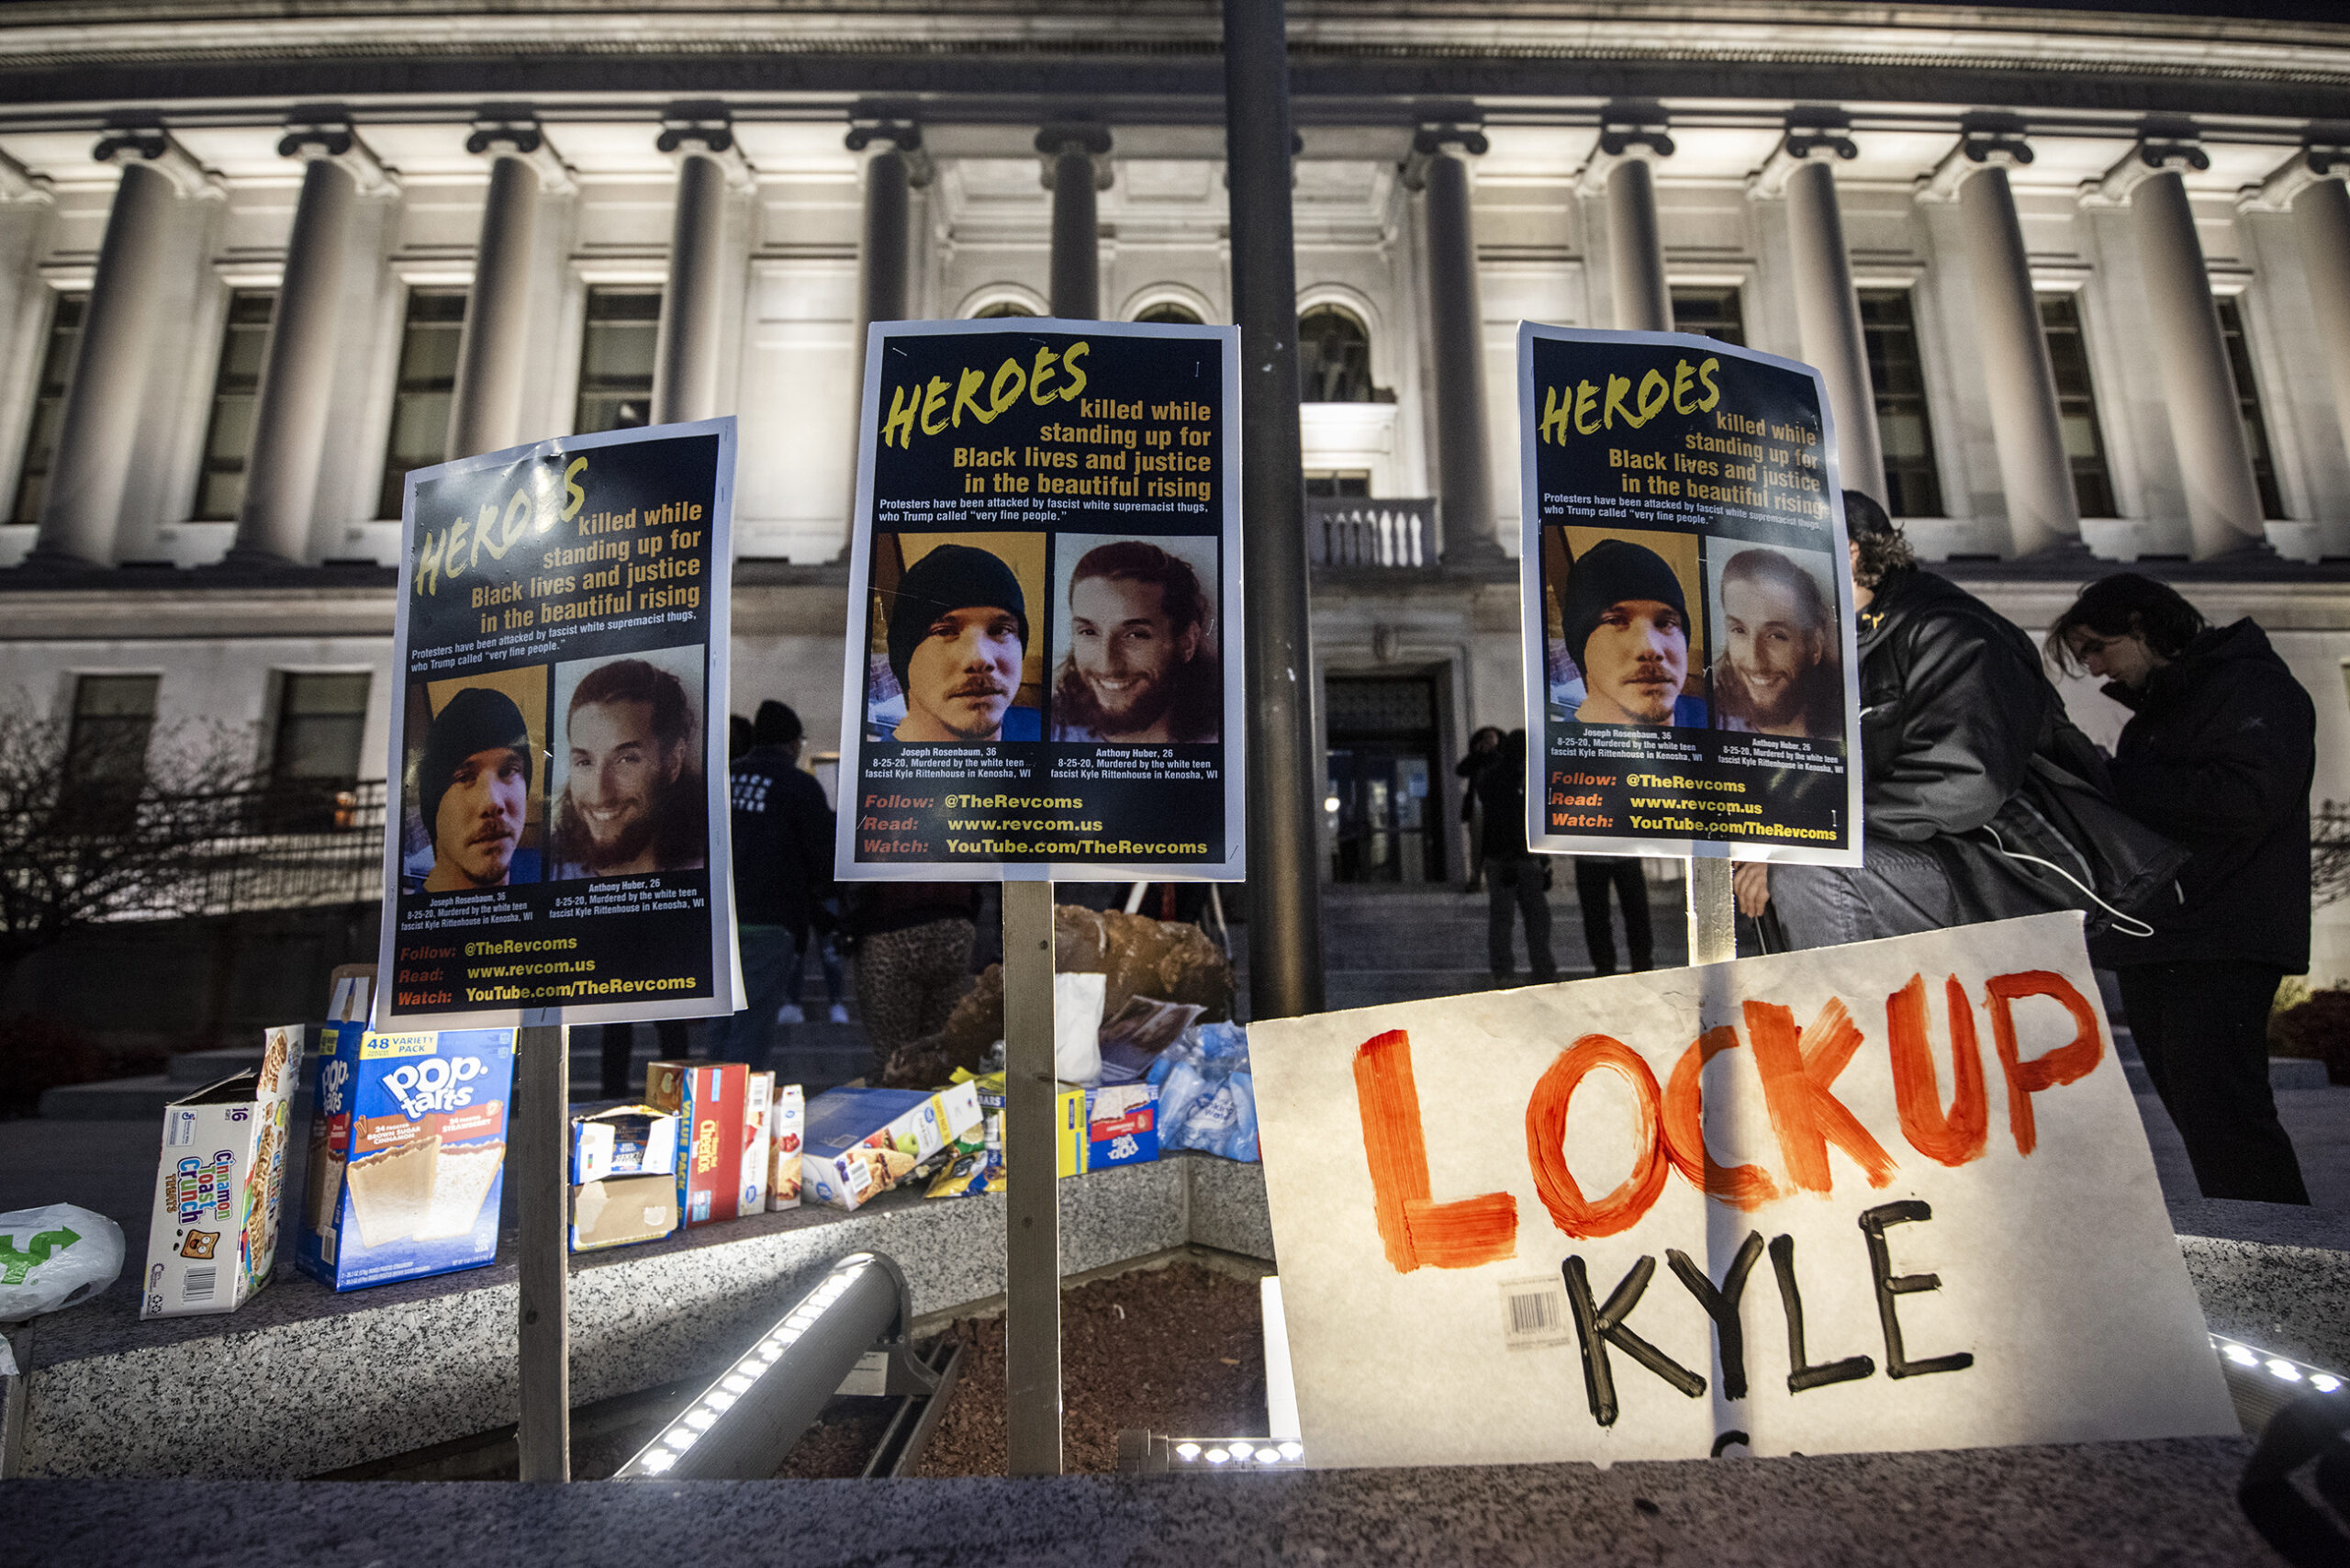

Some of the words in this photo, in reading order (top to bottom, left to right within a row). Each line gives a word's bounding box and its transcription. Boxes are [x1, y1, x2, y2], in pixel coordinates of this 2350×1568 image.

[880, 342, 1089, 449] HEROES
[1080, 398, 1143, 420] killed
[1151, 401, 1211, 420] while
[1538, 358, 1719, 446] HEROES
[1040, 422, 1136, 449] standing
[1145, 430, 1171, 450] up
[1180, 426, 1211, 446] for
[1716, 410, 1765, 436] killed
[1771, 423, 1819, 450] while
[953, 446, 1016, 467] Black
[1024, 446, 1078, 468] lives
[1085, 450, 1125, 470] and
[1134, 451, 1211, 475] justice
[1685, 431, 1763, 463] standing
[1769, 447, 1789, 467] up
[1795, 449, 1818, 467] for
[965, 473, 984, 493] in
[992, 472, 1029, 493] the
[1037, 473, 1138, 497] beautiful
[1147, 476, 1211, 501] rising
[1609, 448, 1667, 470] Black
[1673, 454, 1718, 476] lives
[1724, 464, 1756, 482] and
[1762, 465, 1820, 497] justice
[879, 498, 930, 509] Protesters
[933, 498, 957, 509] have
[959, 498, 984, 508] been
[987, 498, 1029, 508] attacked
[1032, 499, 1045, 510] by
[1047, 499, 1080, 509] fascist
[1082, 500, 1110, 510] white
[1113, 501, 1174, 512] supremacist
[1621, 473, 1640, 493] in
[1647, 476, 1680, 496] the
[1686, 479, 1769, 510] beautiful
[1774, 493, 1830, 520] rising
[578, 508, 636, 536] killed
[643, 501, 702, 526] while
[878, 511, 900, 521] who
[902, 510, 933, 522] Trump
[936, 510, 967, 521] called
[1000, 510, 1019, 520] fine
[543, 539, 630, 568] standing
[637, 535, 663, 557] up
[670, 529, 701, 550] for
[472, 580, 523, 609] Black
[530, 575, 576, 598] lives
[582, 566, 620, 589] and
[626, 558, 699, 588] justice
[481, 612, 497, 633] in
[503, 608, 533, 629] the
[541, 590, 632, 623] beautiful
[640, 586, 699, 610] rising
[411, 645, 453, 659] Protesters
[454, 642, 475, 653] have
[476, 638, 497, 649] been
[498, 631, 533, 645] attacked
[536, 630, 546, 641] by
[548, 625, 577, 637] fascist
[579, 622, 605, 633] white
[607, 614, 665, 630] supremacist
[410, 661, 428, 672] who
[430, 658, 455, 669] Trump
[457, 652, 483, 666] called
[509, 646, 525, 656] fine
[901, 747, 930, 757] Joseph
[985, 747, 996, 756] 36
[911, 758, 951, 767] Murdered
[953, 758, 963, 768] by
[965, 758, 979, 767] the
[980, 758, 1003, 767] white
[1005, 758, 1024, 767] teen
[1095, 748, 1130, 759] Anthony
[1162, 748, 1173, 757] 26
[1096, 758, 1136, 768] Murdered
[1139, 759, 1149, 769] by
[1151, 759, 1165, 768] the
[1167, 759, 1190, 768] white
[1192, 760, 1211, 768] teen
[865, 768, 892, 778] fascist
[895, 769, 913, 779] Kyle
[915, 768, 965, 778] Rittenhouse
[968, 768, 976, 778] in
[1019, 768, 1031, 778] WI
[1050, 769, 1078, 778] fascist
[1080, 769, 1099, 779] Kyle
[1102, 769, 1151, 778] Rittenhouse
[1154, 770, 1162, 778] in
[1206, 770, 1217, 778] WI
[1551, 771, 1617, 786] Follow:
[1626, 773, 1746, 792] @TheRevcoms
[865, 794, 934, 808] Follow:
[945, 794, 1083, 808] @TheRevcoms
[1552, 793, 1603, 808] Read:
[1629, 797, 1762, 814] www.revcom.us
[864, 818, 919, 831] Read:
[947, 820, 1102, 831] www.revcom.us
[1552, 812, 1614, 827] Watch:
[1629, 816, 1836, 841] YouTube.com/TheRevcoms
[864, 839, 929, 853] Watch:
[946, 839, 1207, 855] YouTube.com/TheRevcoms
[400, 946, 455, 961] Follow:
[464, 937, 577, 957] @TheRevcoms
[398, 968, 443, 983] Read:
[466, 959, 595, 979] www.revcom.us
[398, 991, 452, 1005] Watch:
[465, 977, 696, 1002] YouTube.com/TheRevcoms
[367, 1038, 389, 1049] 48
[392, 1036, 434, 1045] VARIETY
[398, 1045, 425, 1053] PACK
[231, 1107, 249, 1122] 16
[680, 1101, 691, 1147] VALUE
[677, 1152, 688, 1190] PACK
[165, 1173, 177, 1214] TREATS
[180, 1159, 204, 1224] Crunch
[197, 1166, 217, 1209] Toast
[216, 1152, 234, 1219] Cinnamon
[1562, 1201, 1973, 1427] KYLE
